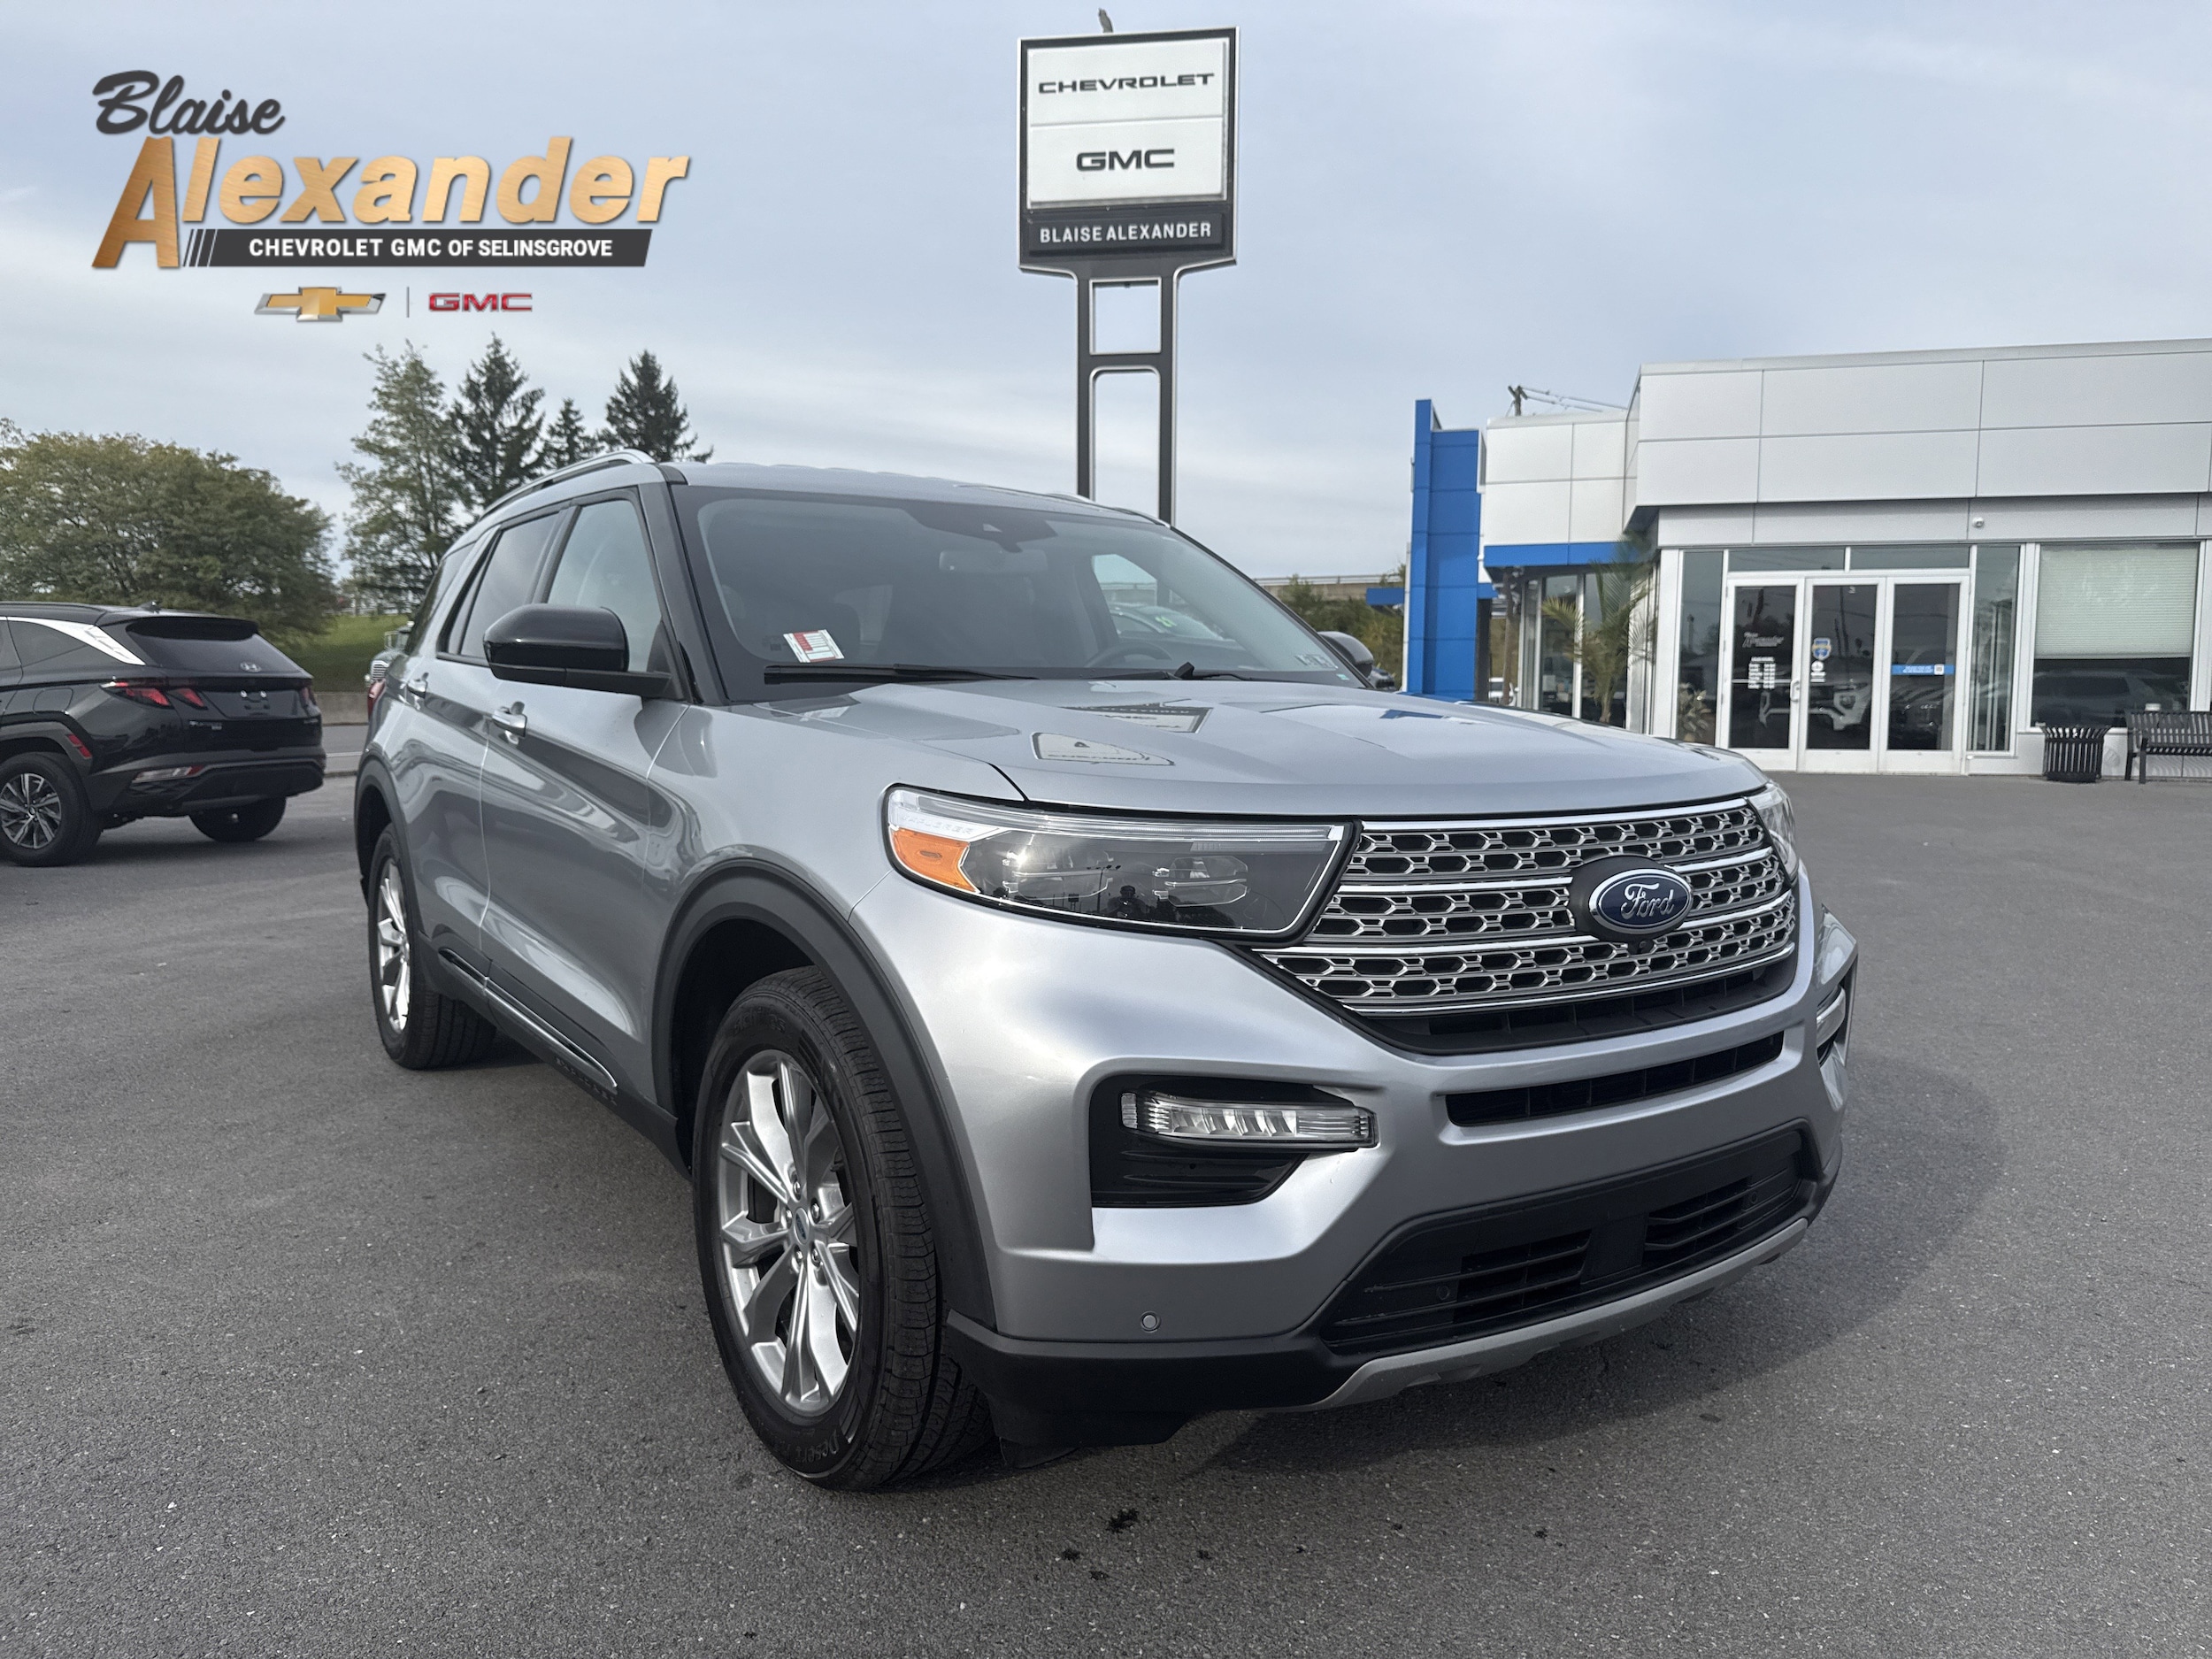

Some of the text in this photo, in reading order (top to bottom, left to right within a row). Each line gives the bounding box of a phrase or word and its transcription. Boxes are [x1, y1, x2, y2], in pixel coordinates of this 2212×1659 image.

[1038, 73, 1215, 94] CHEVROLET
[1076, 148, 1175, 172] GMC
[1040, 222, 1212, 243] BLAISE ALEXANDER
[1621, 883, 1675, 919] Ford
